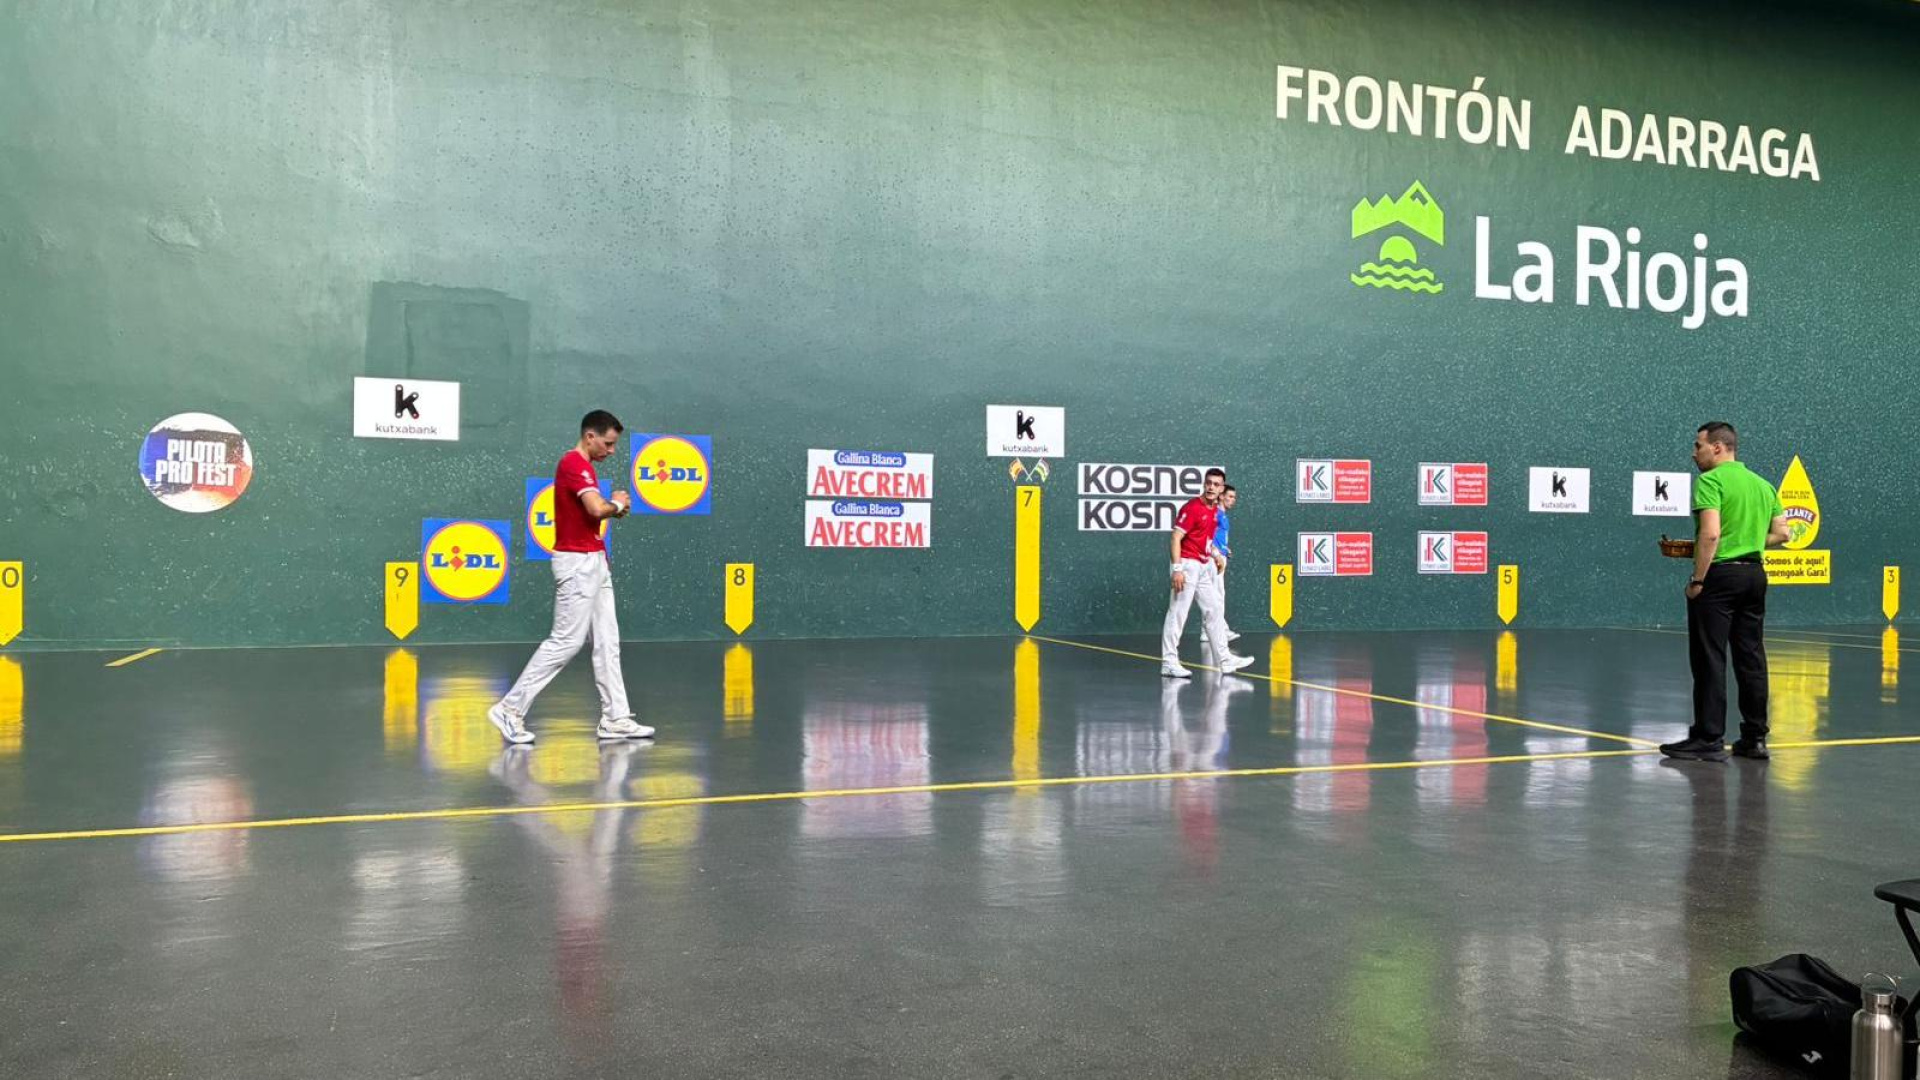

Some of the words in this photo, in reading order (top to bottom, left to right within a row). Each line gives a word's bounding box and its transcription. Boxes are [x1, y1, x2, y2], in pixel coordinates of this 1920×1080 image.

[1276, 64, 1532, 151] FRONTÓN
[1564, 105, 1821, 181] ADARRAGA
[1475, 215, 1554, 303] La
[1576, 225, 1749, 329] Rioja
[375, 422, 437, 435] kutxabank
[166, 439, 227, 463] PILOTA
[1002, 444, 1049, 453] kutxabank
[837, 451, 870, 465] Gallina
[871, 453, 902, 466] Blanca
[155, 459, 193, 485] PRO
[197, 462, 237, 487] FEST
[812, 465, 926, 498] AVECREM
[1023, 490, 1033, 508] 7
[1541, 501, 1577, 509] kutxabank
[834, 502, 868, 515] Gallina
[869, 503, 901, 516] Blanca
[1644, 504, 1678, 512] kutxabank
[810, 516, 924, 547] AVECREM
[1793, 556, 1803, 565] de
[394, 567, 409, 588] 9
[733, 567, 746, 587] 8
[1277, 568, 1287, 584] 6
[1504, 569, 1512, 585] 5
[1888, 569, 1895, 583] 3
